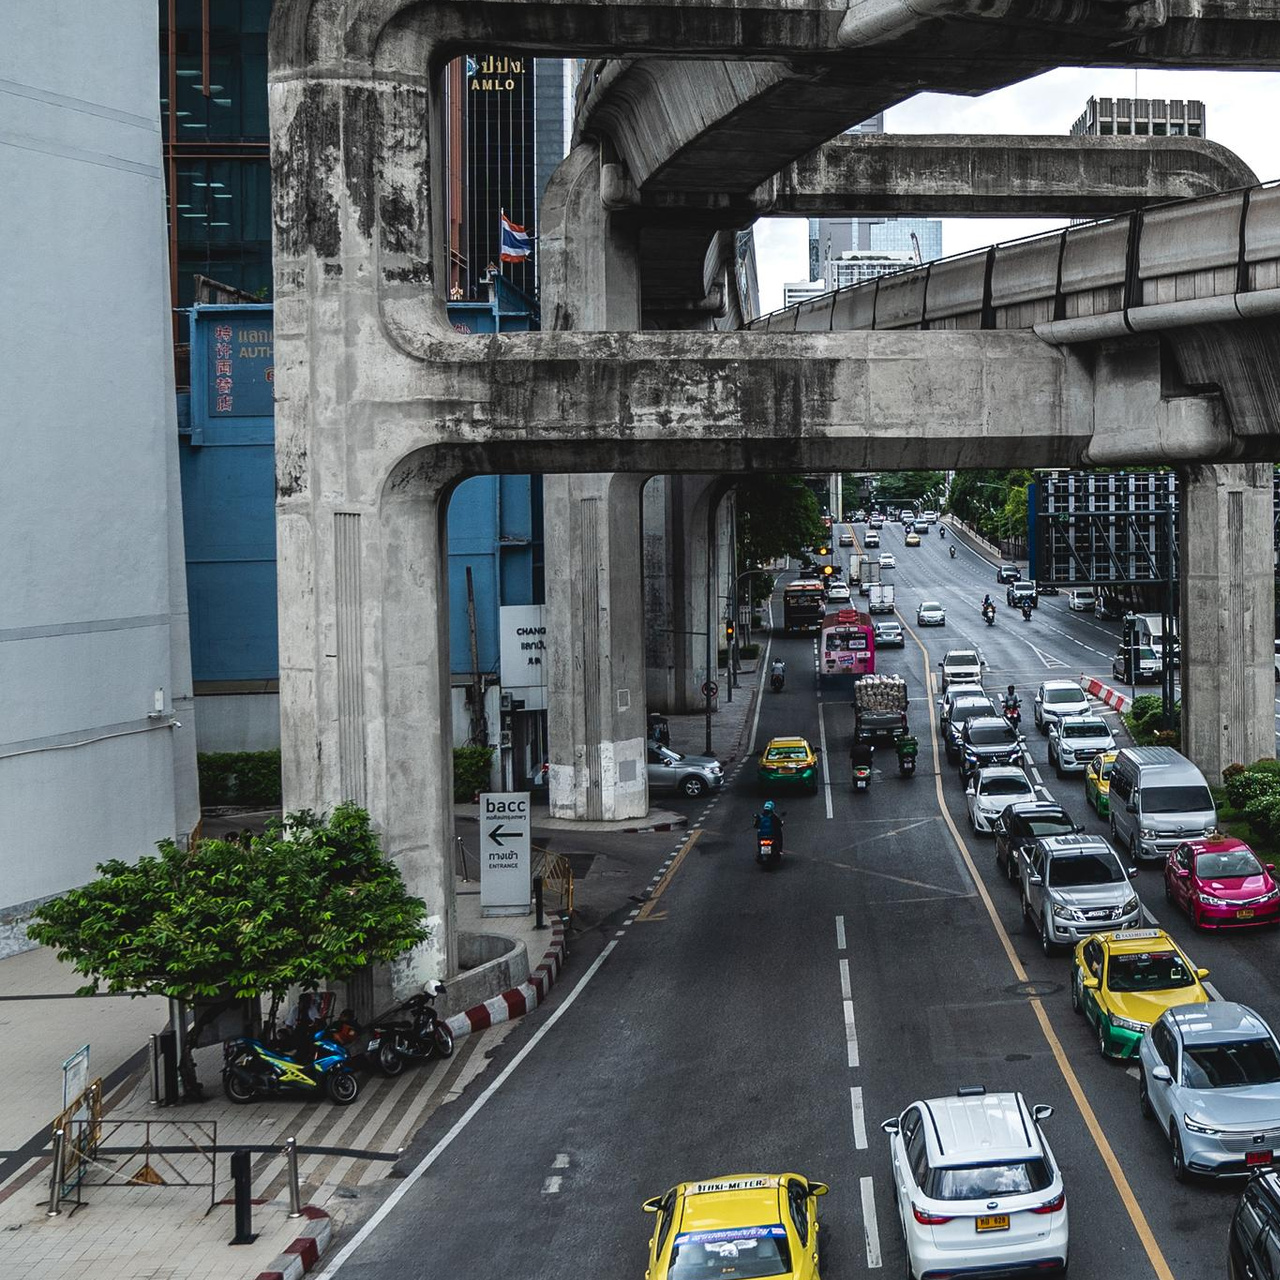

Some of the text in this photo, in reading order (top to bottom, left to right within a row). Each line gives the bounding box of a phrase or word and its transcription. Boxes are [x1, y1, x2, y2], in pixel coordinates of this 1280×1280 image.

[471, 79, 515, 91] AMLO
[486, 798, 526, 813] bacc
[489, 850, 518, 860] ทางเข้า
